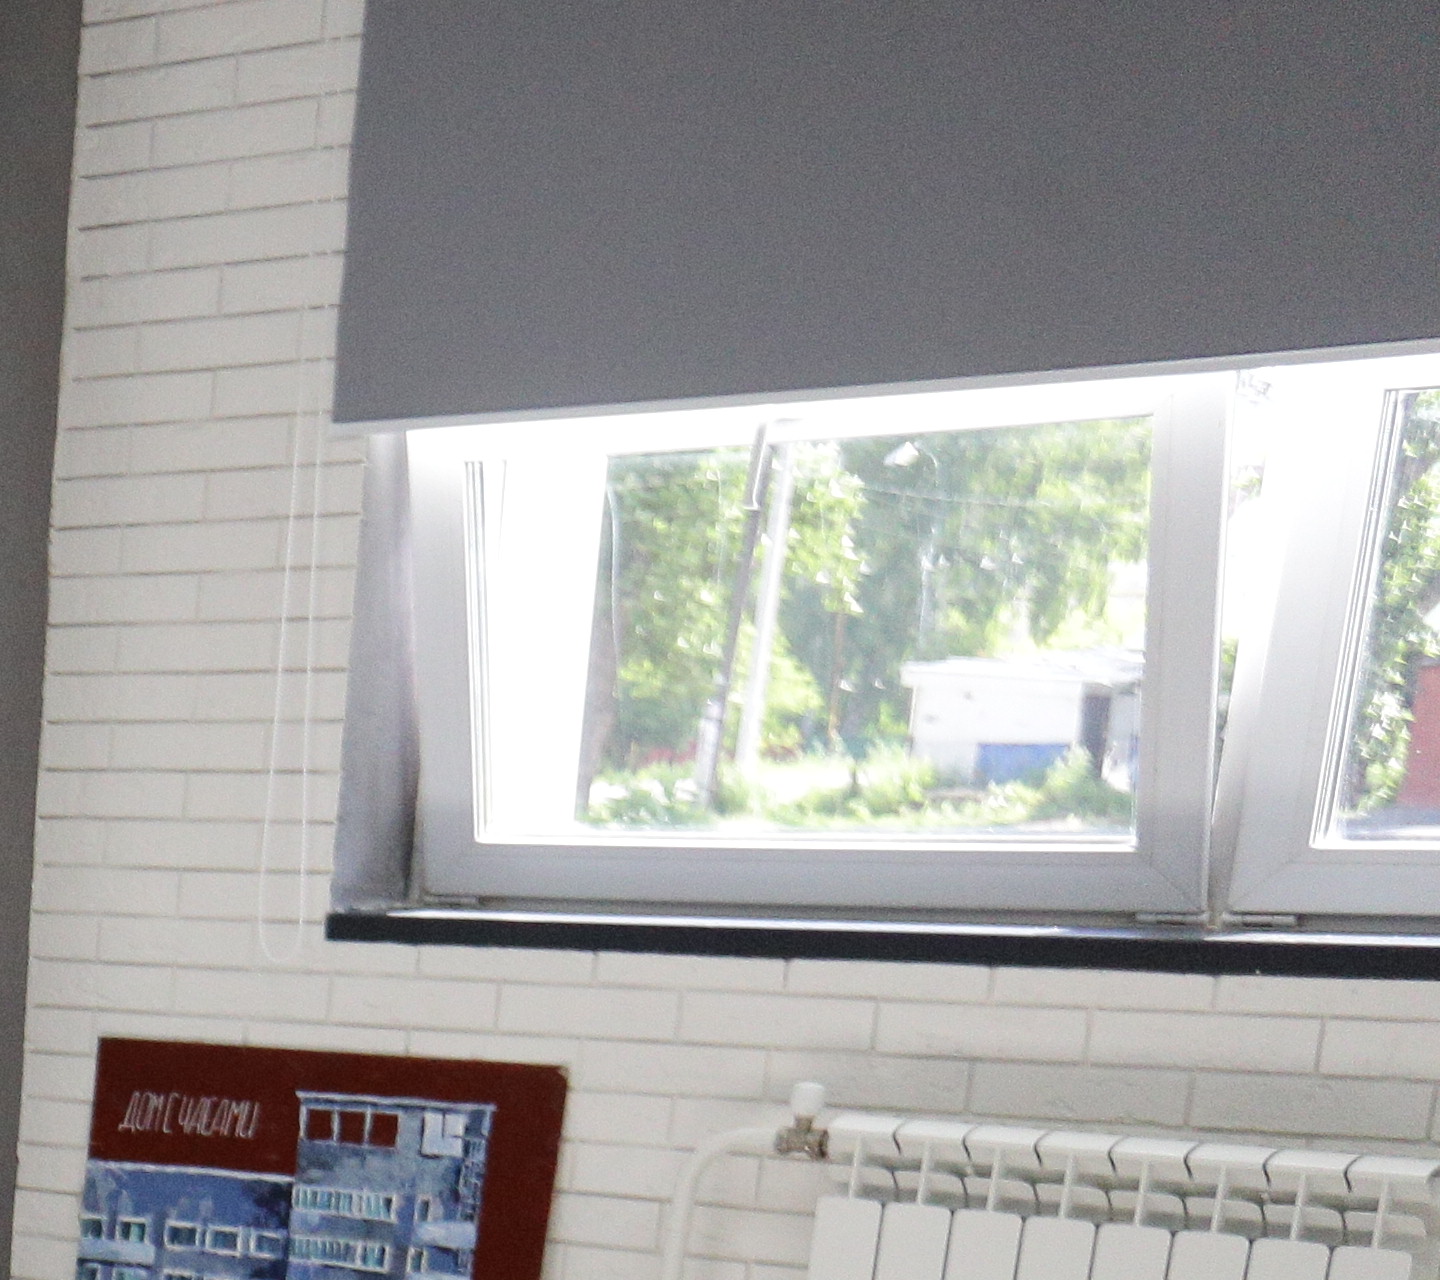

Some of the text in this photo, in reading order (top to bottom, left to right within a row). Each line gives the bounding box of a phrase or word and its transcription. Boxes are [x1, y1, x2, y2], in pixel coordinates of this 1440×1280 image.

[118, 1091, 261, 1138] ДОМ С ЧАСАМИ
